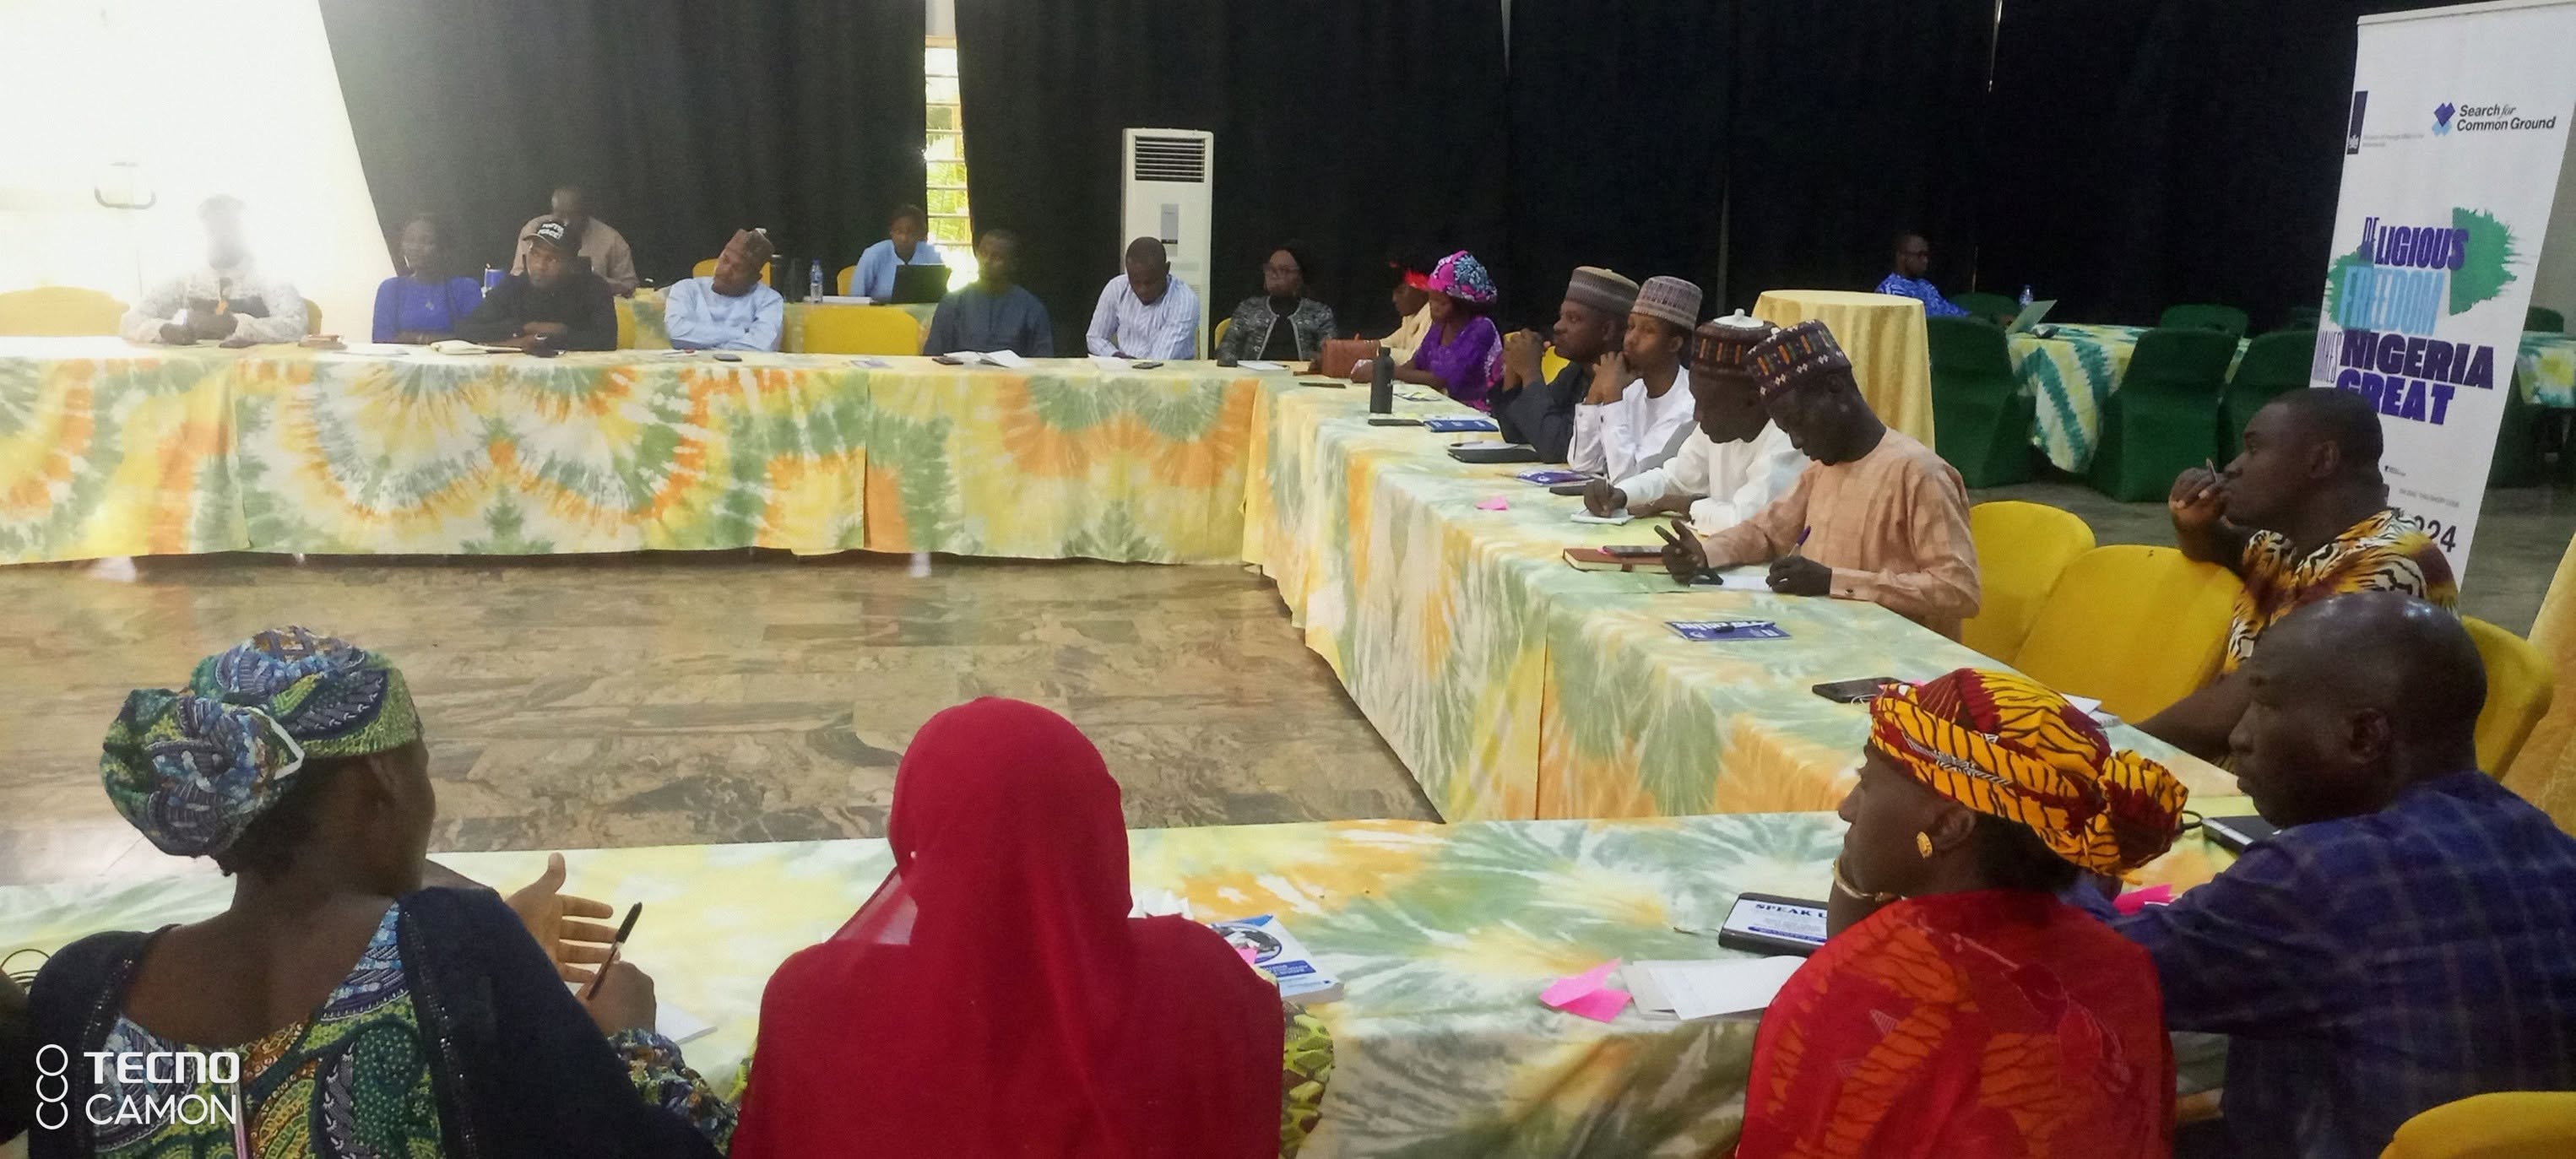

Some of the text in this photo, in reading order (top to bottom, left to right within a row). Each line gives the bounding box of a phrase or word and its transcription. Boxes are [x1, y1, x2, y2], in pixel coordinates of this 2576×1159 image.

[2459, 103, 2517, 120] Search for
[2456, 115, 2557, 132] Common Ground
[2337, 264, 2445, 337] FREEDOM
[2340, 328, 2494, 390] NIGERIA
[1755, 903, 1811, 917] SPEAK
